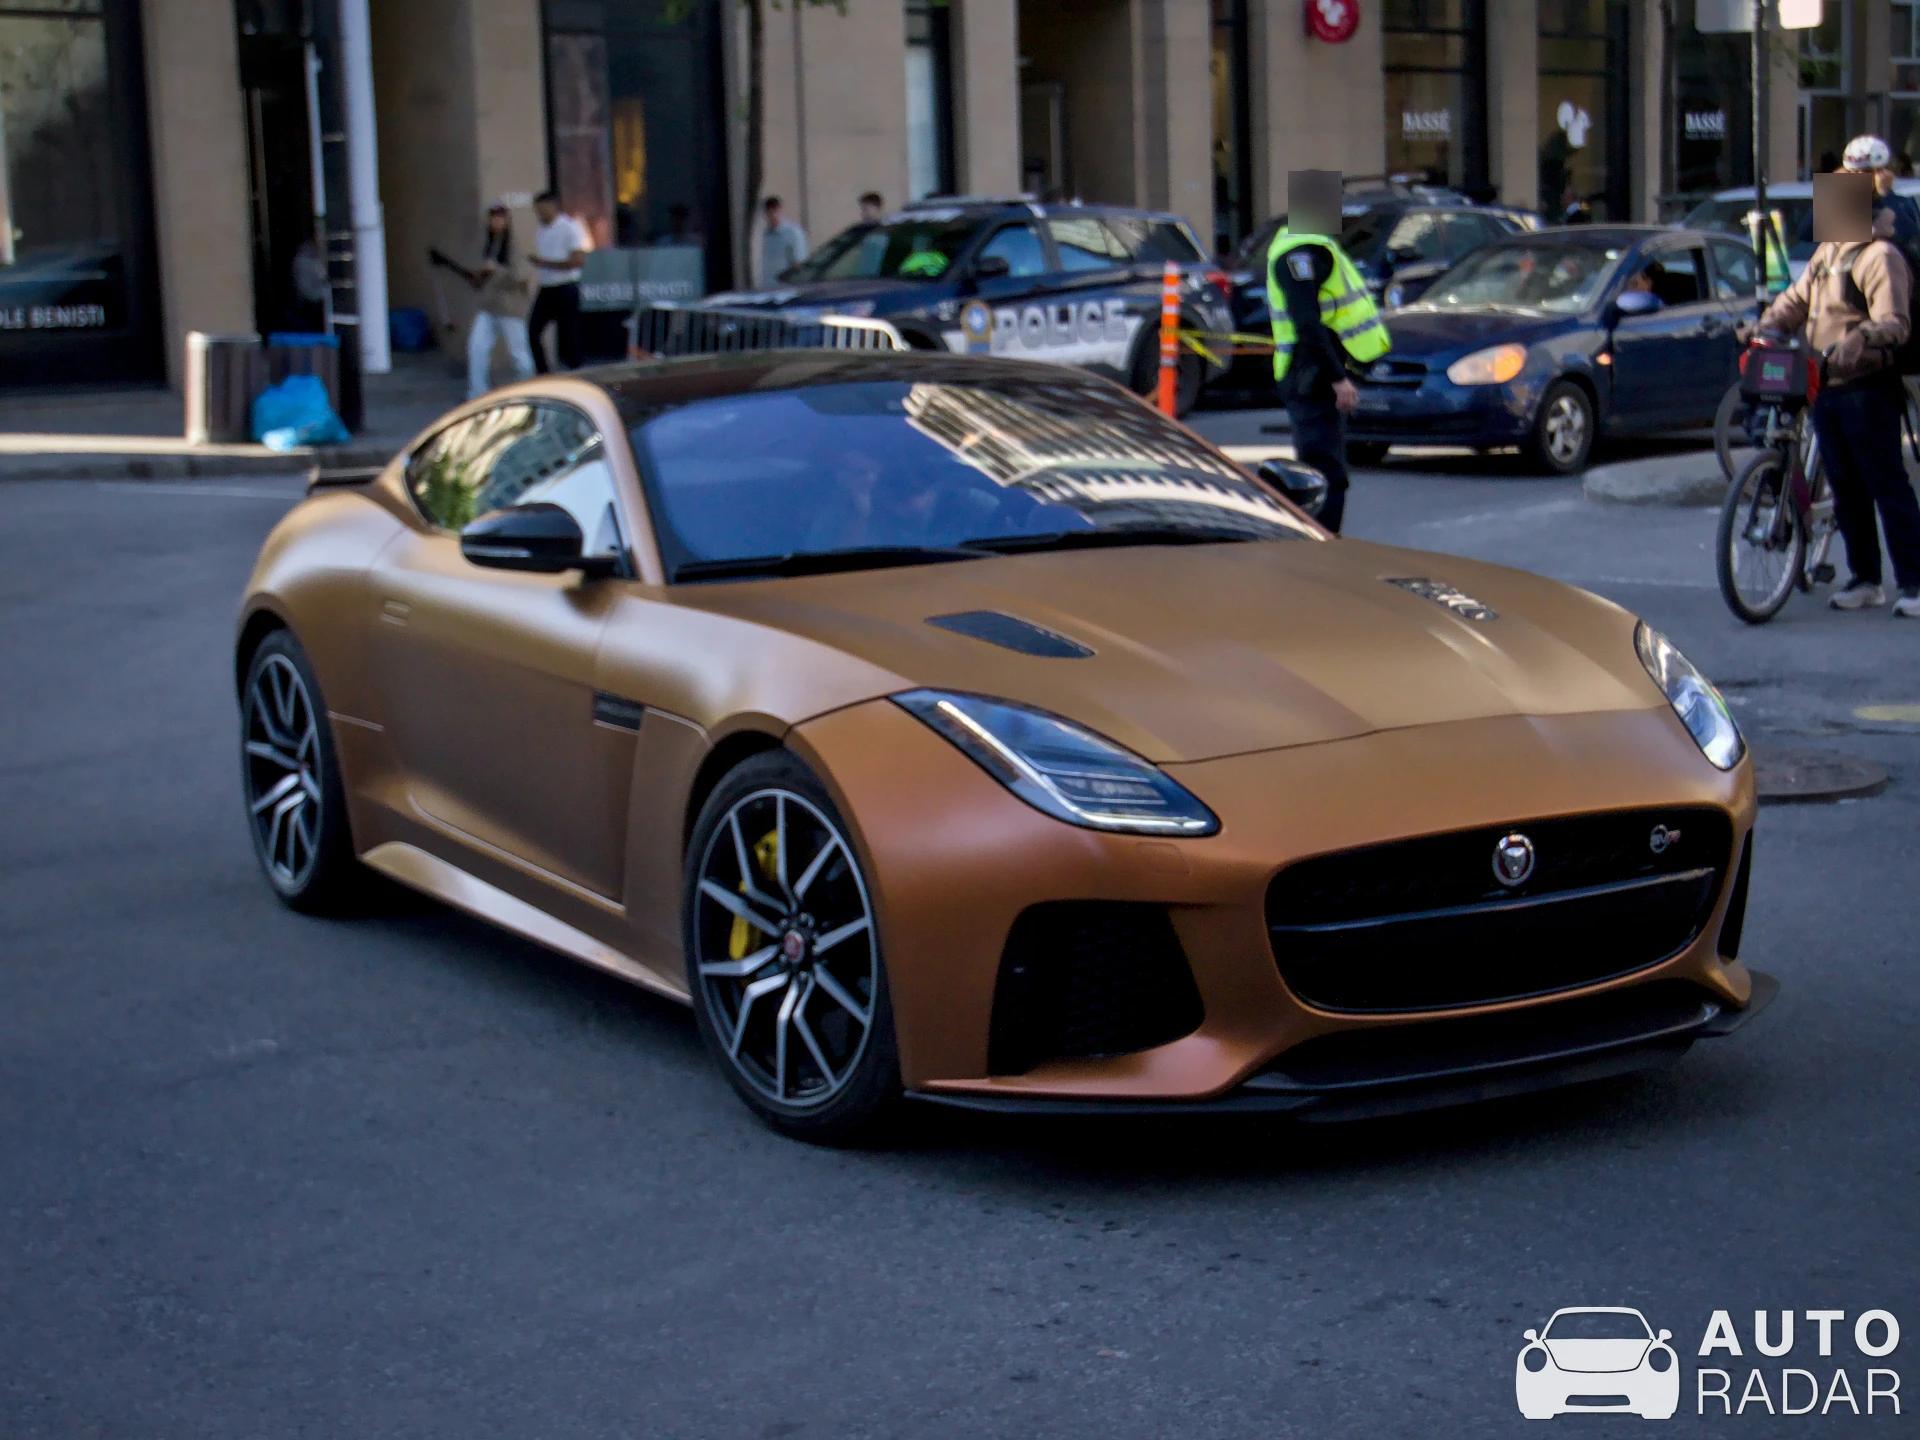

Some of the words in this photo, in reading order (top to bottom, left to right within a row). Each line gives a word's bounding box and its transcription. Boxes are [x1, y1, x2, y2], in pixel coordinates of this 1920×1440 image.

[0, 307, 25, 329] LE
[31, 304, 105, 328] BENISTI
[993, 298, 1128, 351] POLICE
